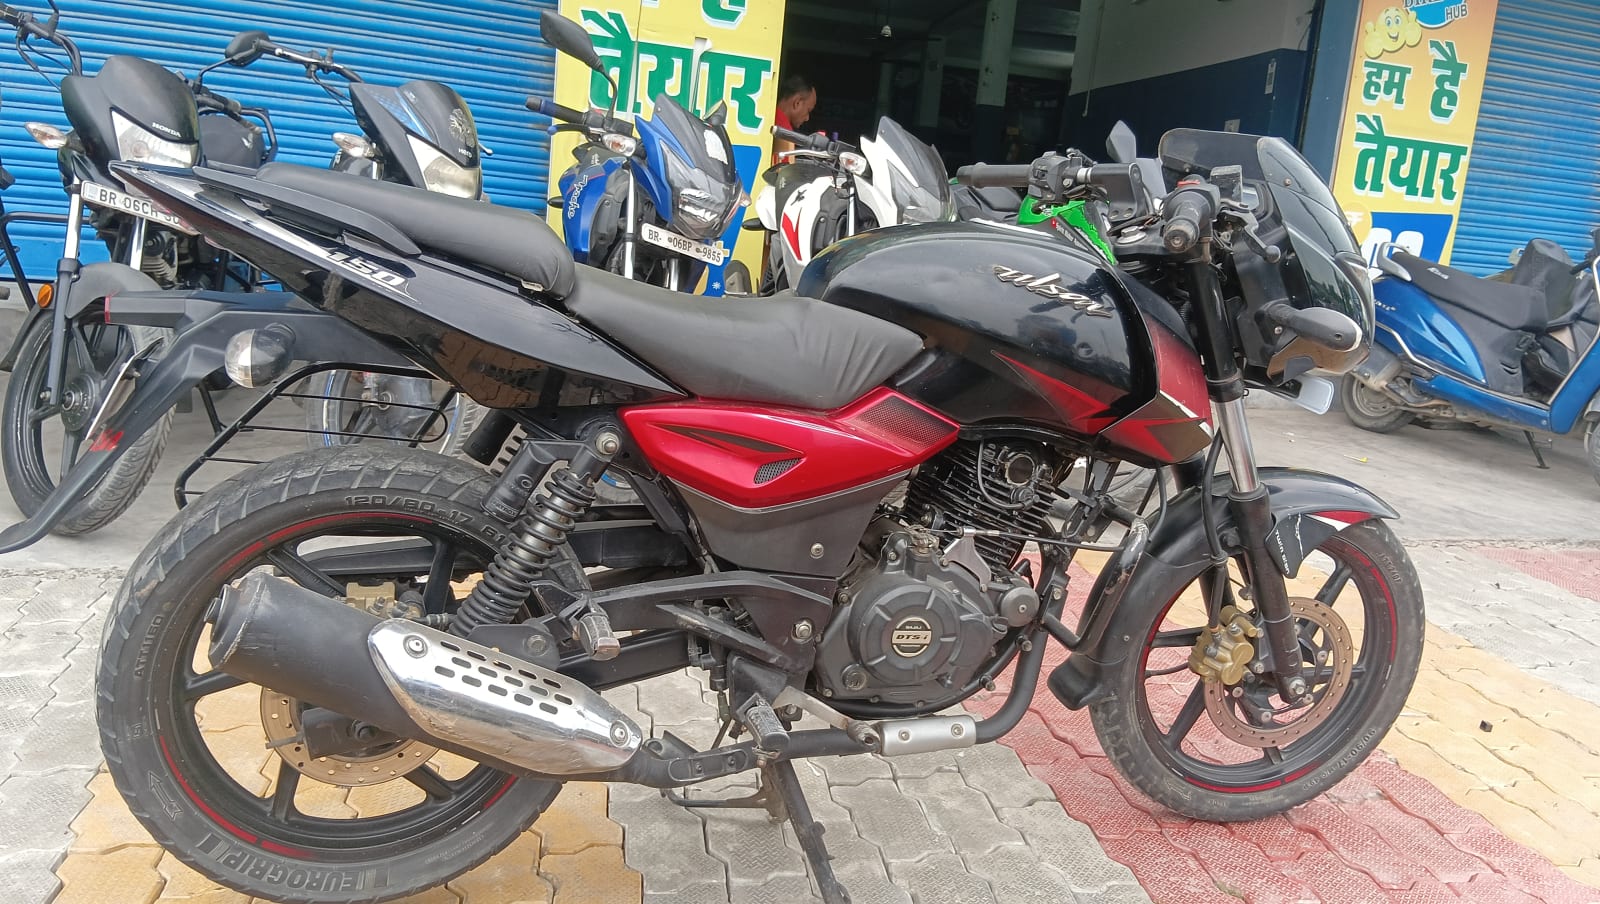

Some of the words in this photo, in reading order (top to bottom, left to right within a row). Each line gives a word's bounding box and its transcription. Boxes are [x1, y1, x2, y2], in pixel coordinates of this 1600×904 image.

[1445, 4, 1468, 20] HUB
[1362, 60, 1412, 105] हम
[1429, 39, 1468, 119] है
[151, 122, 182, 138] HONDA
[1353, 113, 1469, 201] तैयार
[99, 189, 117, 206] BR
[327, 251, 406, 287] 150
[224, 851, 359, 891] EUROGRIP
